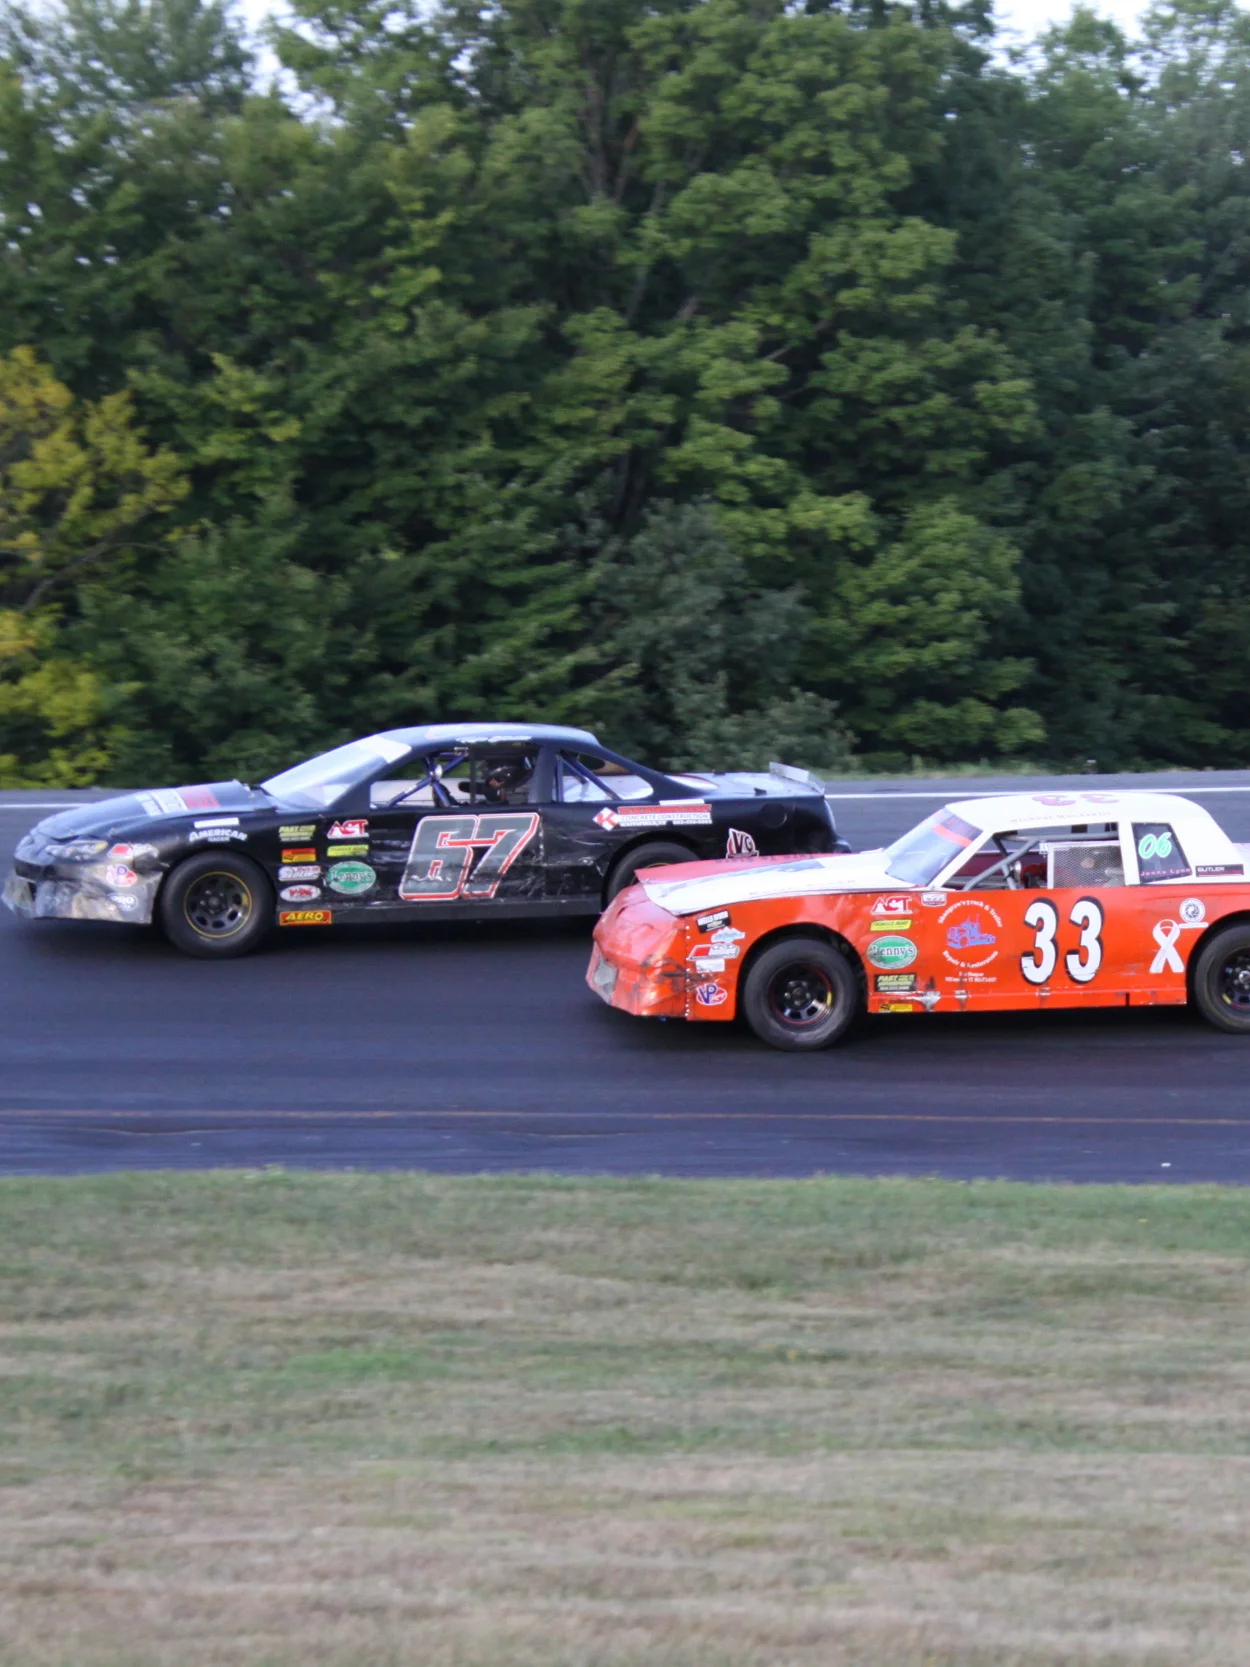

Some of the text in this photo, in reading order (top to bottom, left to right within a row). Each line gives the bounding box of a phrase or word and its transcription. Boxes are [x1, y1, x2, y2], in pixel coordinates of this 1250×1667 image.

[621, 813, 710, 822] CONCRETE CONSTRUCTION
[188, 829, 248, 844] AMERICAN
[327, 818, 369, 839] ACT
[1138, 831, 1172, 860] 06
[400, 812, 541, 901] 67
[1197, 865, 1226, 873] BUTLER
[871, 895, 913, 915] ACT
[284, 911, 324, 921] AERO
[1020, 895, 1104, 985] 33
[871, 944, 914, 957] Lenny's
